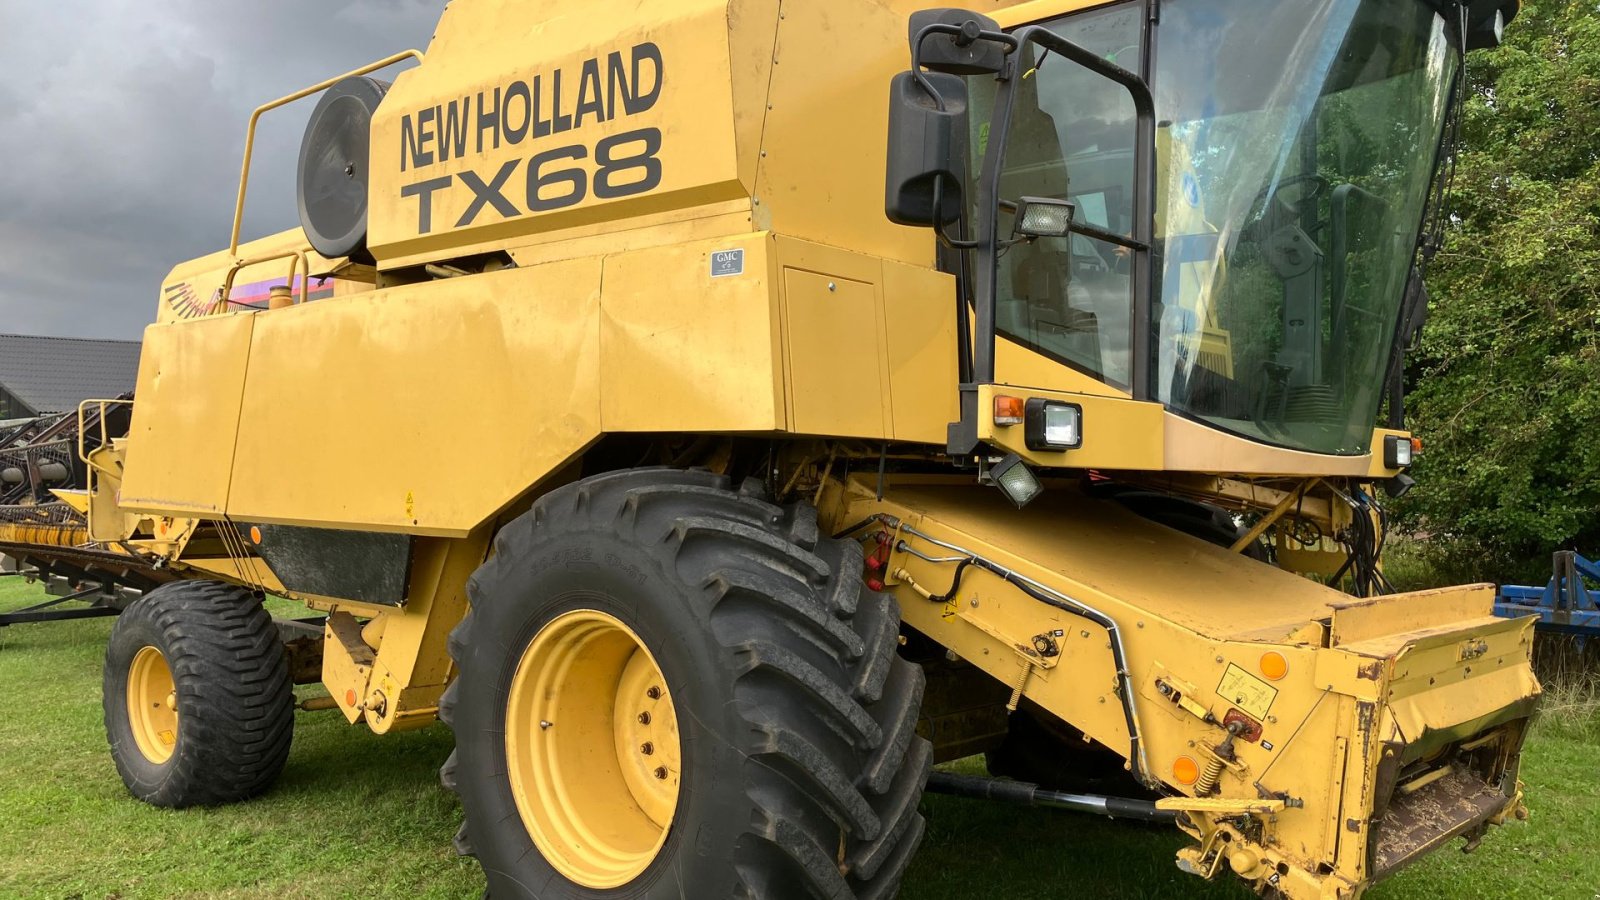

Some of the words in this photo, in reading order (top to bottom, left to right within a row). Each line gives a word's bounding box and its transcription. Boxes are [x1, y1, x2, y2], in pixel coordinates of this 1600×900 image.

[400, 96, 470, 173] NEW
[476, 41, 663, 153] HOLLAND
[400, 127, 662, 235] TX68
[716, 251, 738, 263] GMC
